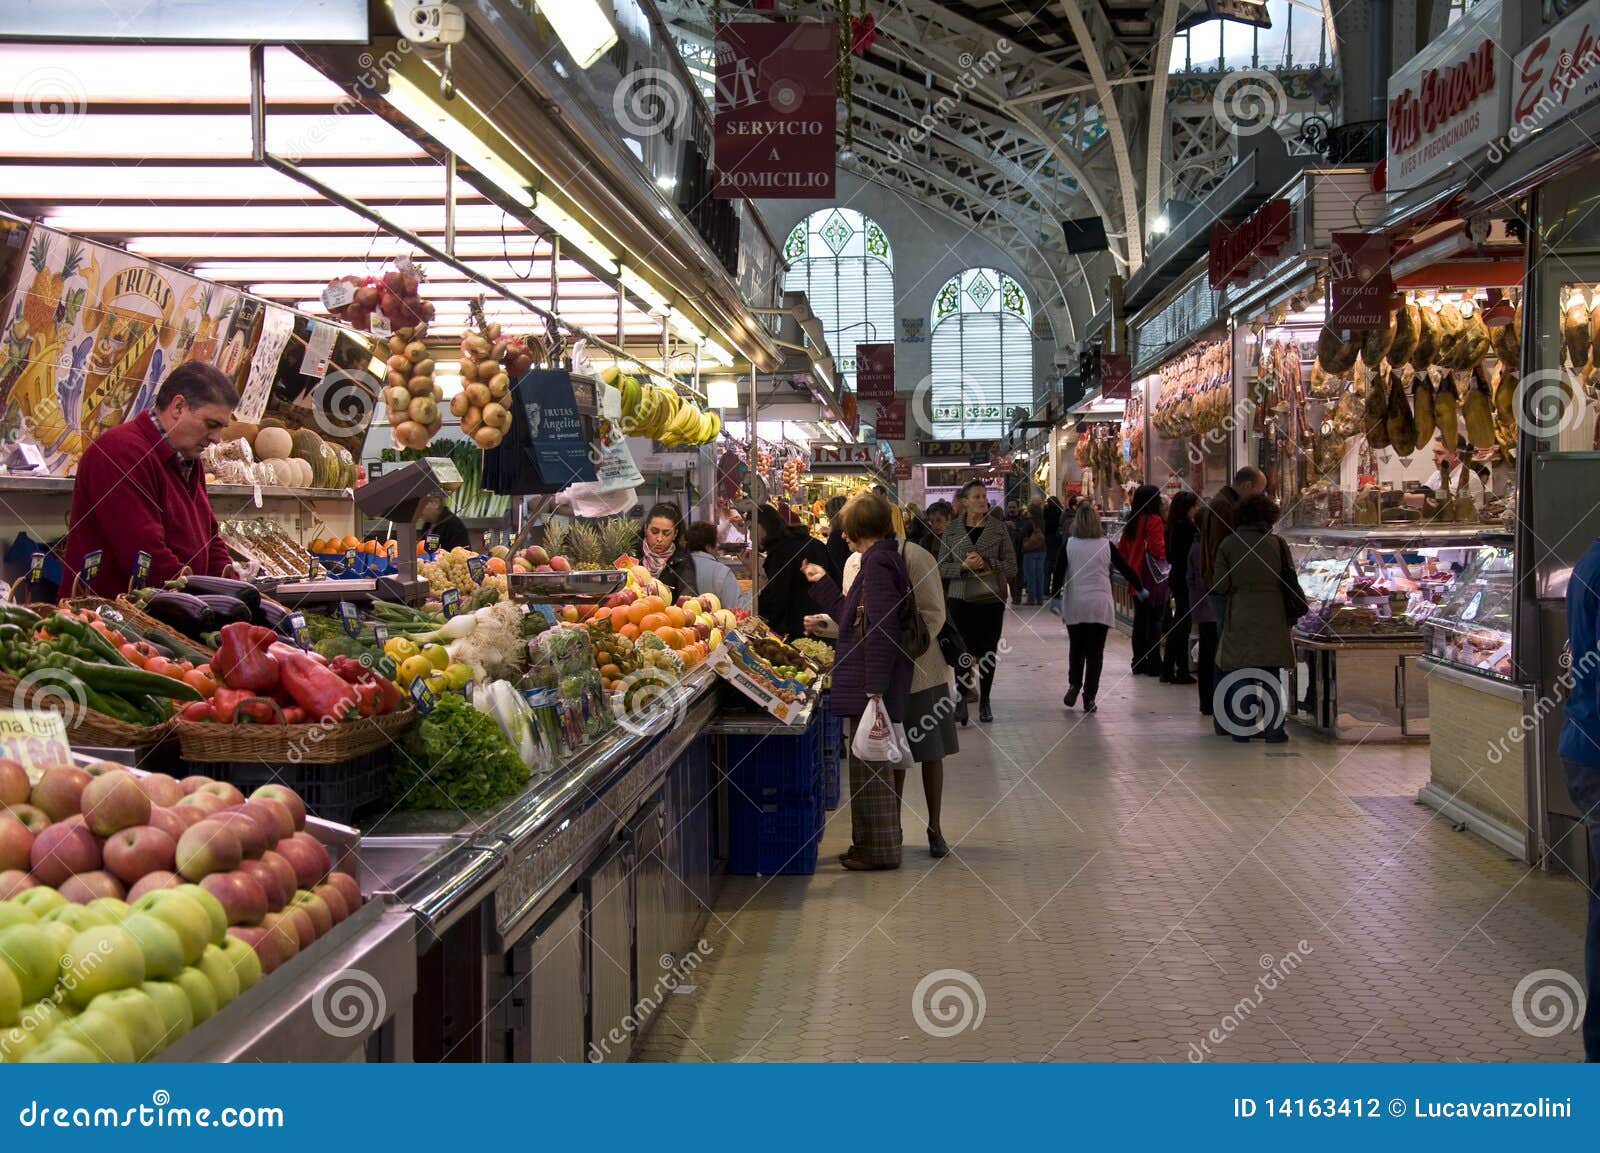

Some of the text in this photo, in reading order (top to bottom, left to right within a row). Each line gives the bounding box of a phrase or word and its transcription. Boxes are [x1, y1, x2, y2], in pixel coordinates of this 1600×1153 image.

[726, 121, 823, 135] SERVICIO
[1423, 111, 1481, 163] PRECOCINADOS
[768, 147, 781, 161] A
[720, 171, 829, 187] DOMICILIO
[115, 268, 172, 311] FRUTAS
[1338, 314, 1383, 325] DOMICILI
[860, 373, 892, 381] SERVICIO
[543, 416, 581, 432] Angelita
